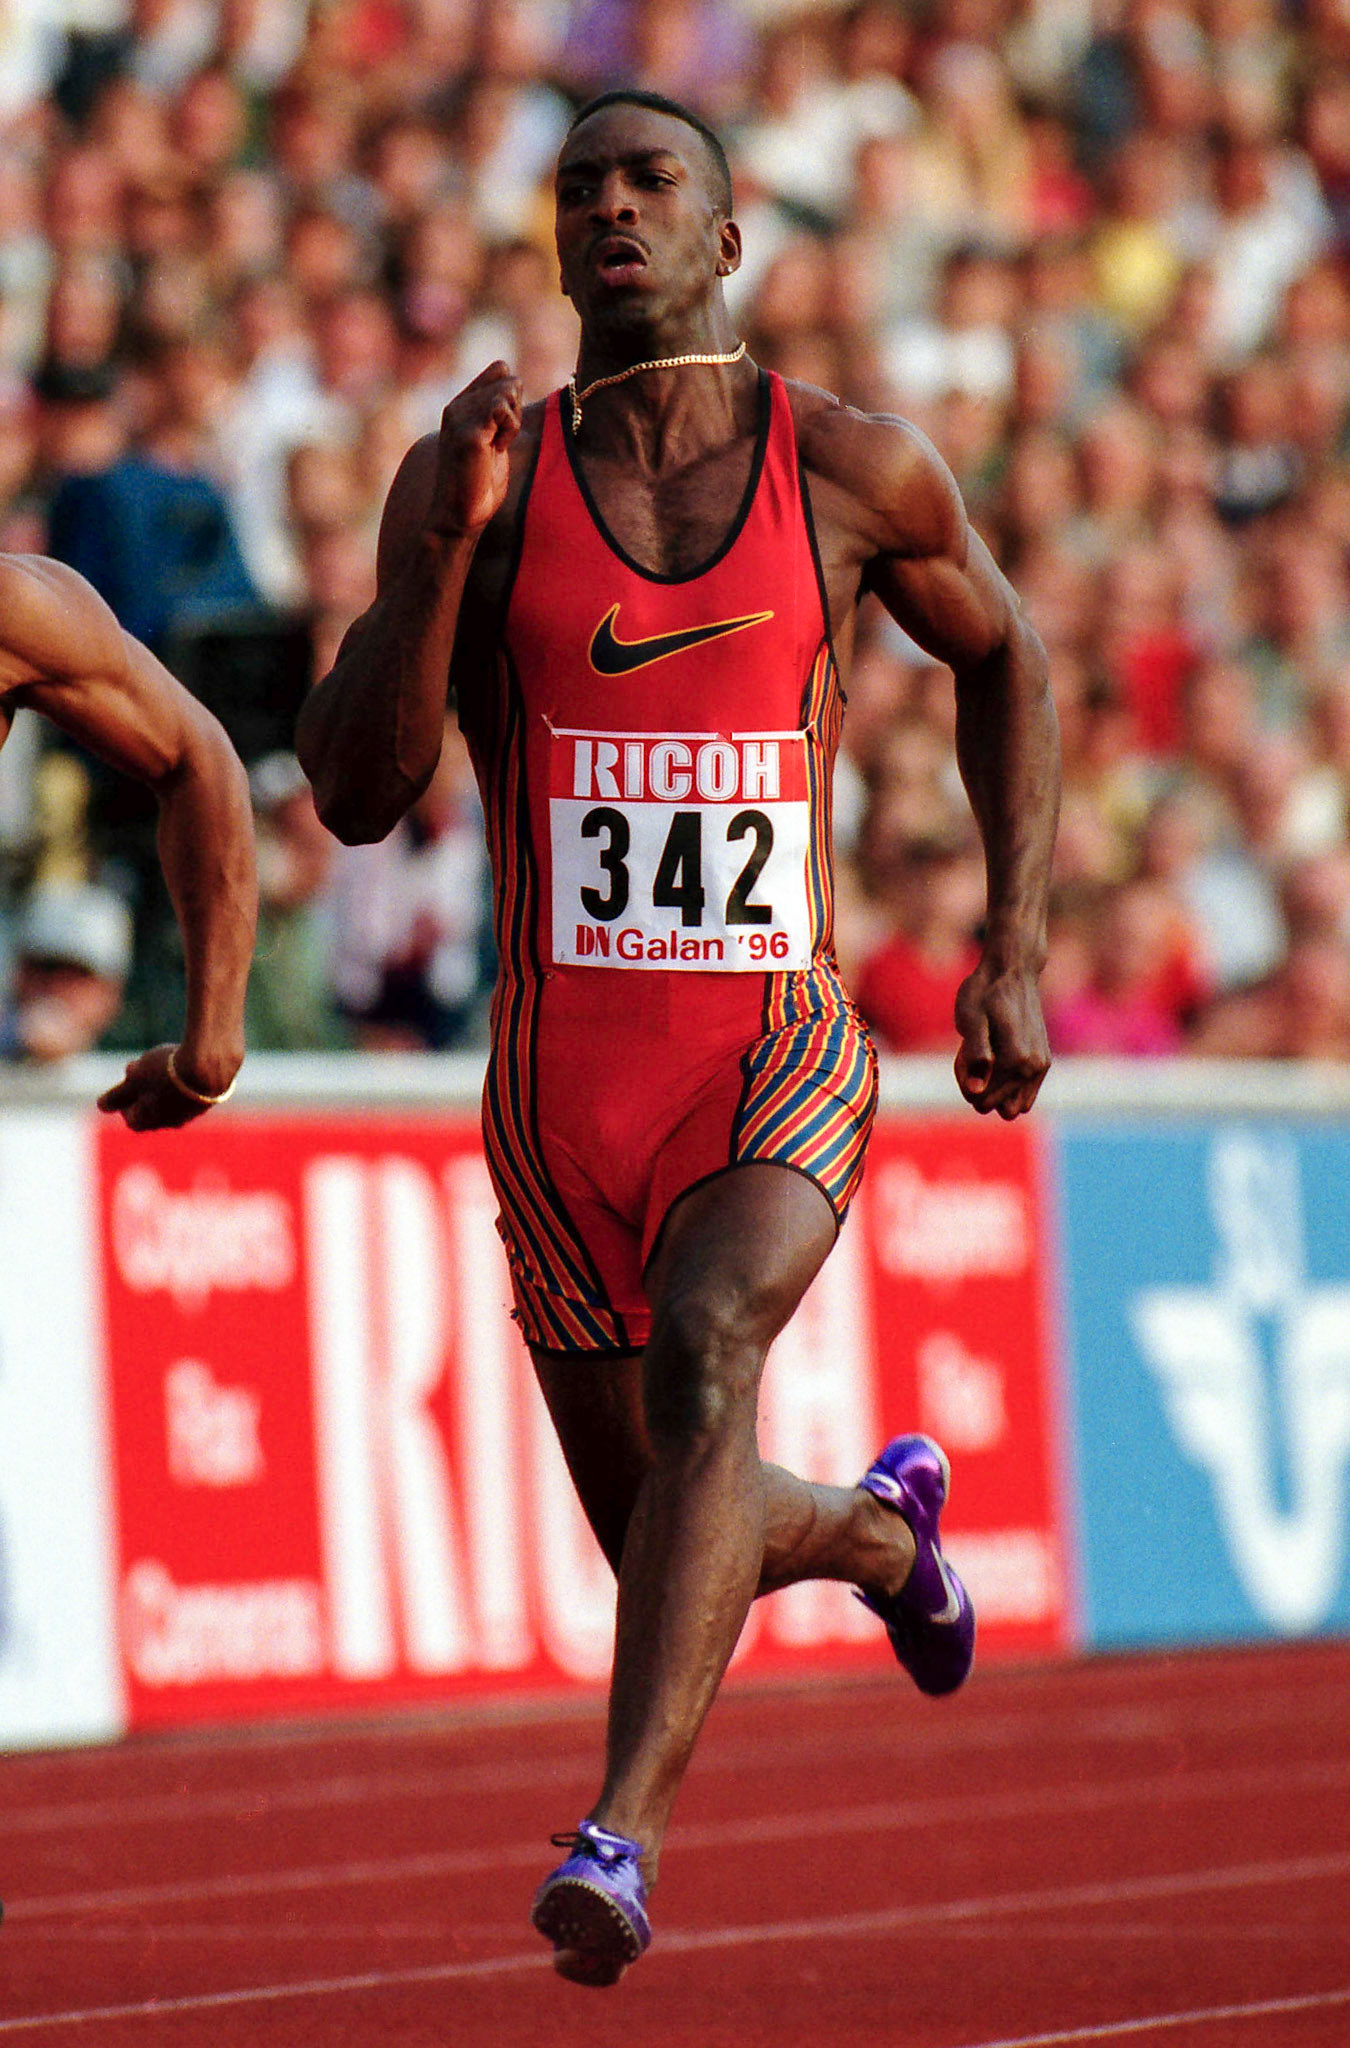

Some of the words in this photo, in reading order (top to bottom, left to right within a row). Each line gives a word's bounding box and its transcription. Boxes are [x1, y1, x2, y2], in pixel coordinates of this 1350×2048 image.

[573, 740, 780, 801] RICOH
[580, 806, 774, 927] 342
[575, 924, 611, 957] DN
[616, 928, 724, 961] Galan
[738, 931, 789, 960] '96
